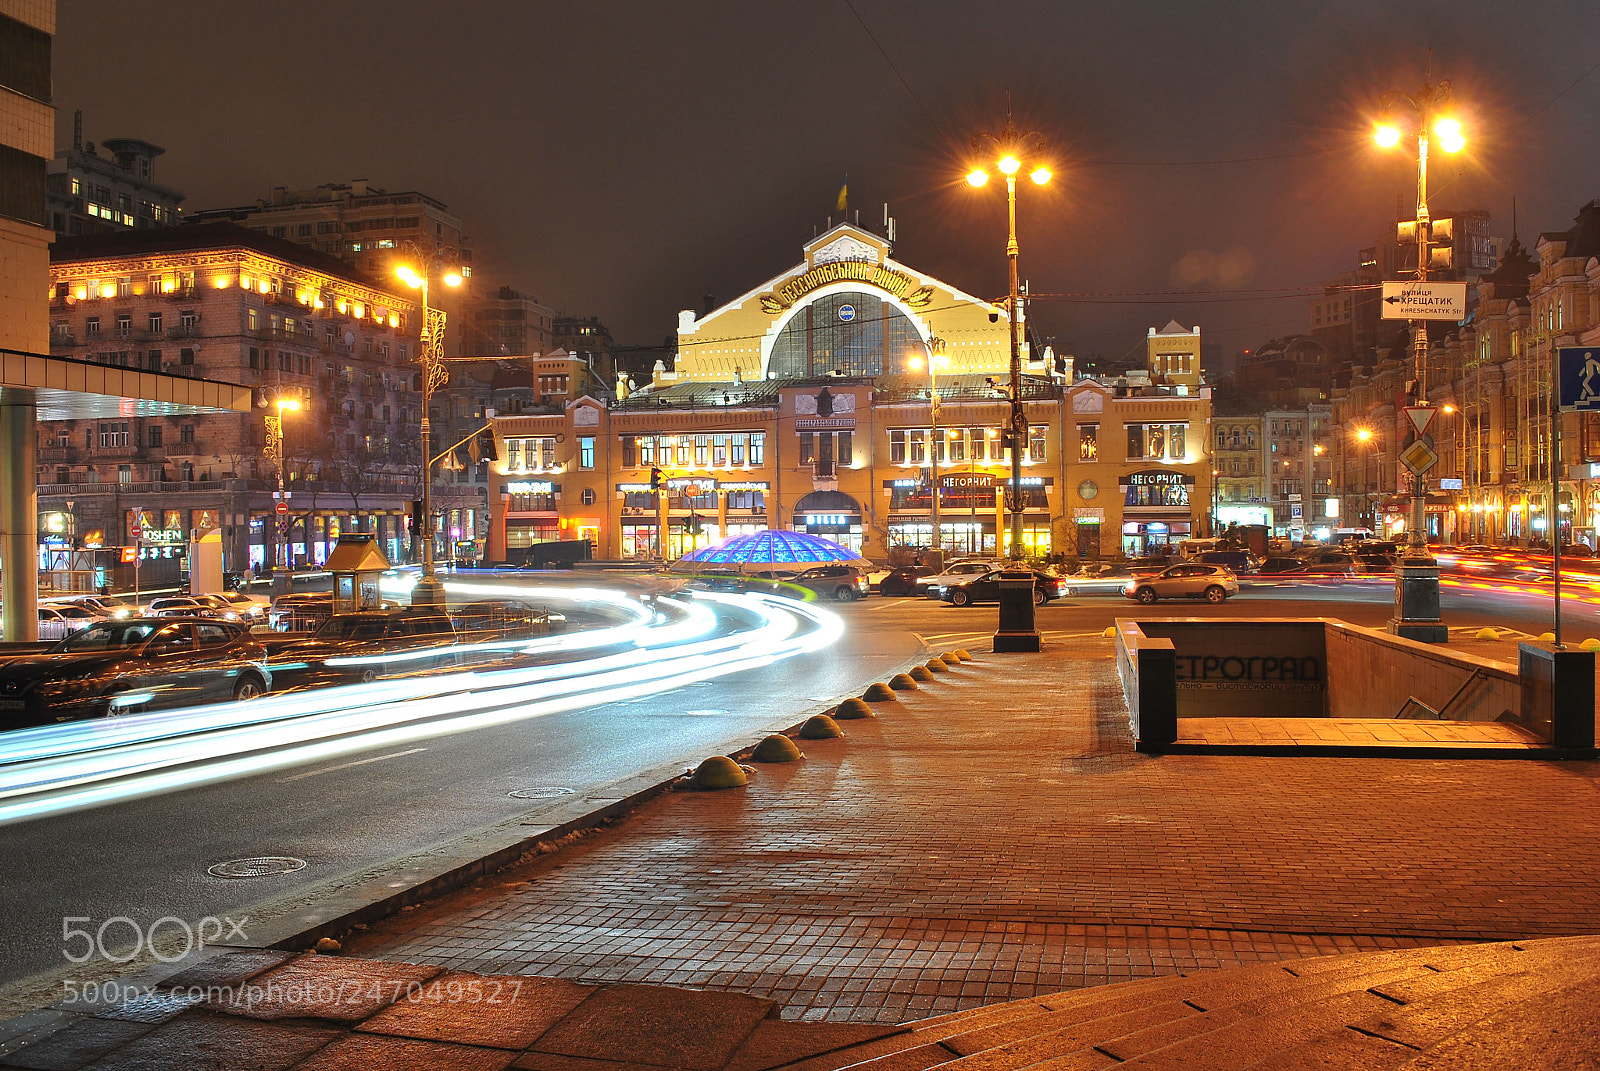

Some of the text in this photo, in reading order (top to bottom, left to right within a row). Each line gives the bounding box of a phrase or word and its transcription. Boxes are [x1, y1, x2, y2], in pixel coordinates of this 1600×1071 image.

[780, 261, 911, 304] БЕССАРАБСЬКИЙ РИНОК
[1401, 297, 1452, 306] ХРЕЩАТИК
[943, 477, 992, 487] НЕГОРЧИТ
[1130, 474, 1183, 484] НЕГОРЧИТ
[806, 514, 846, 525] BILLA
[142, 529, 182, 540] ROSHEN
[1175, 655, 1321, 681] ЕТРОГРАД
